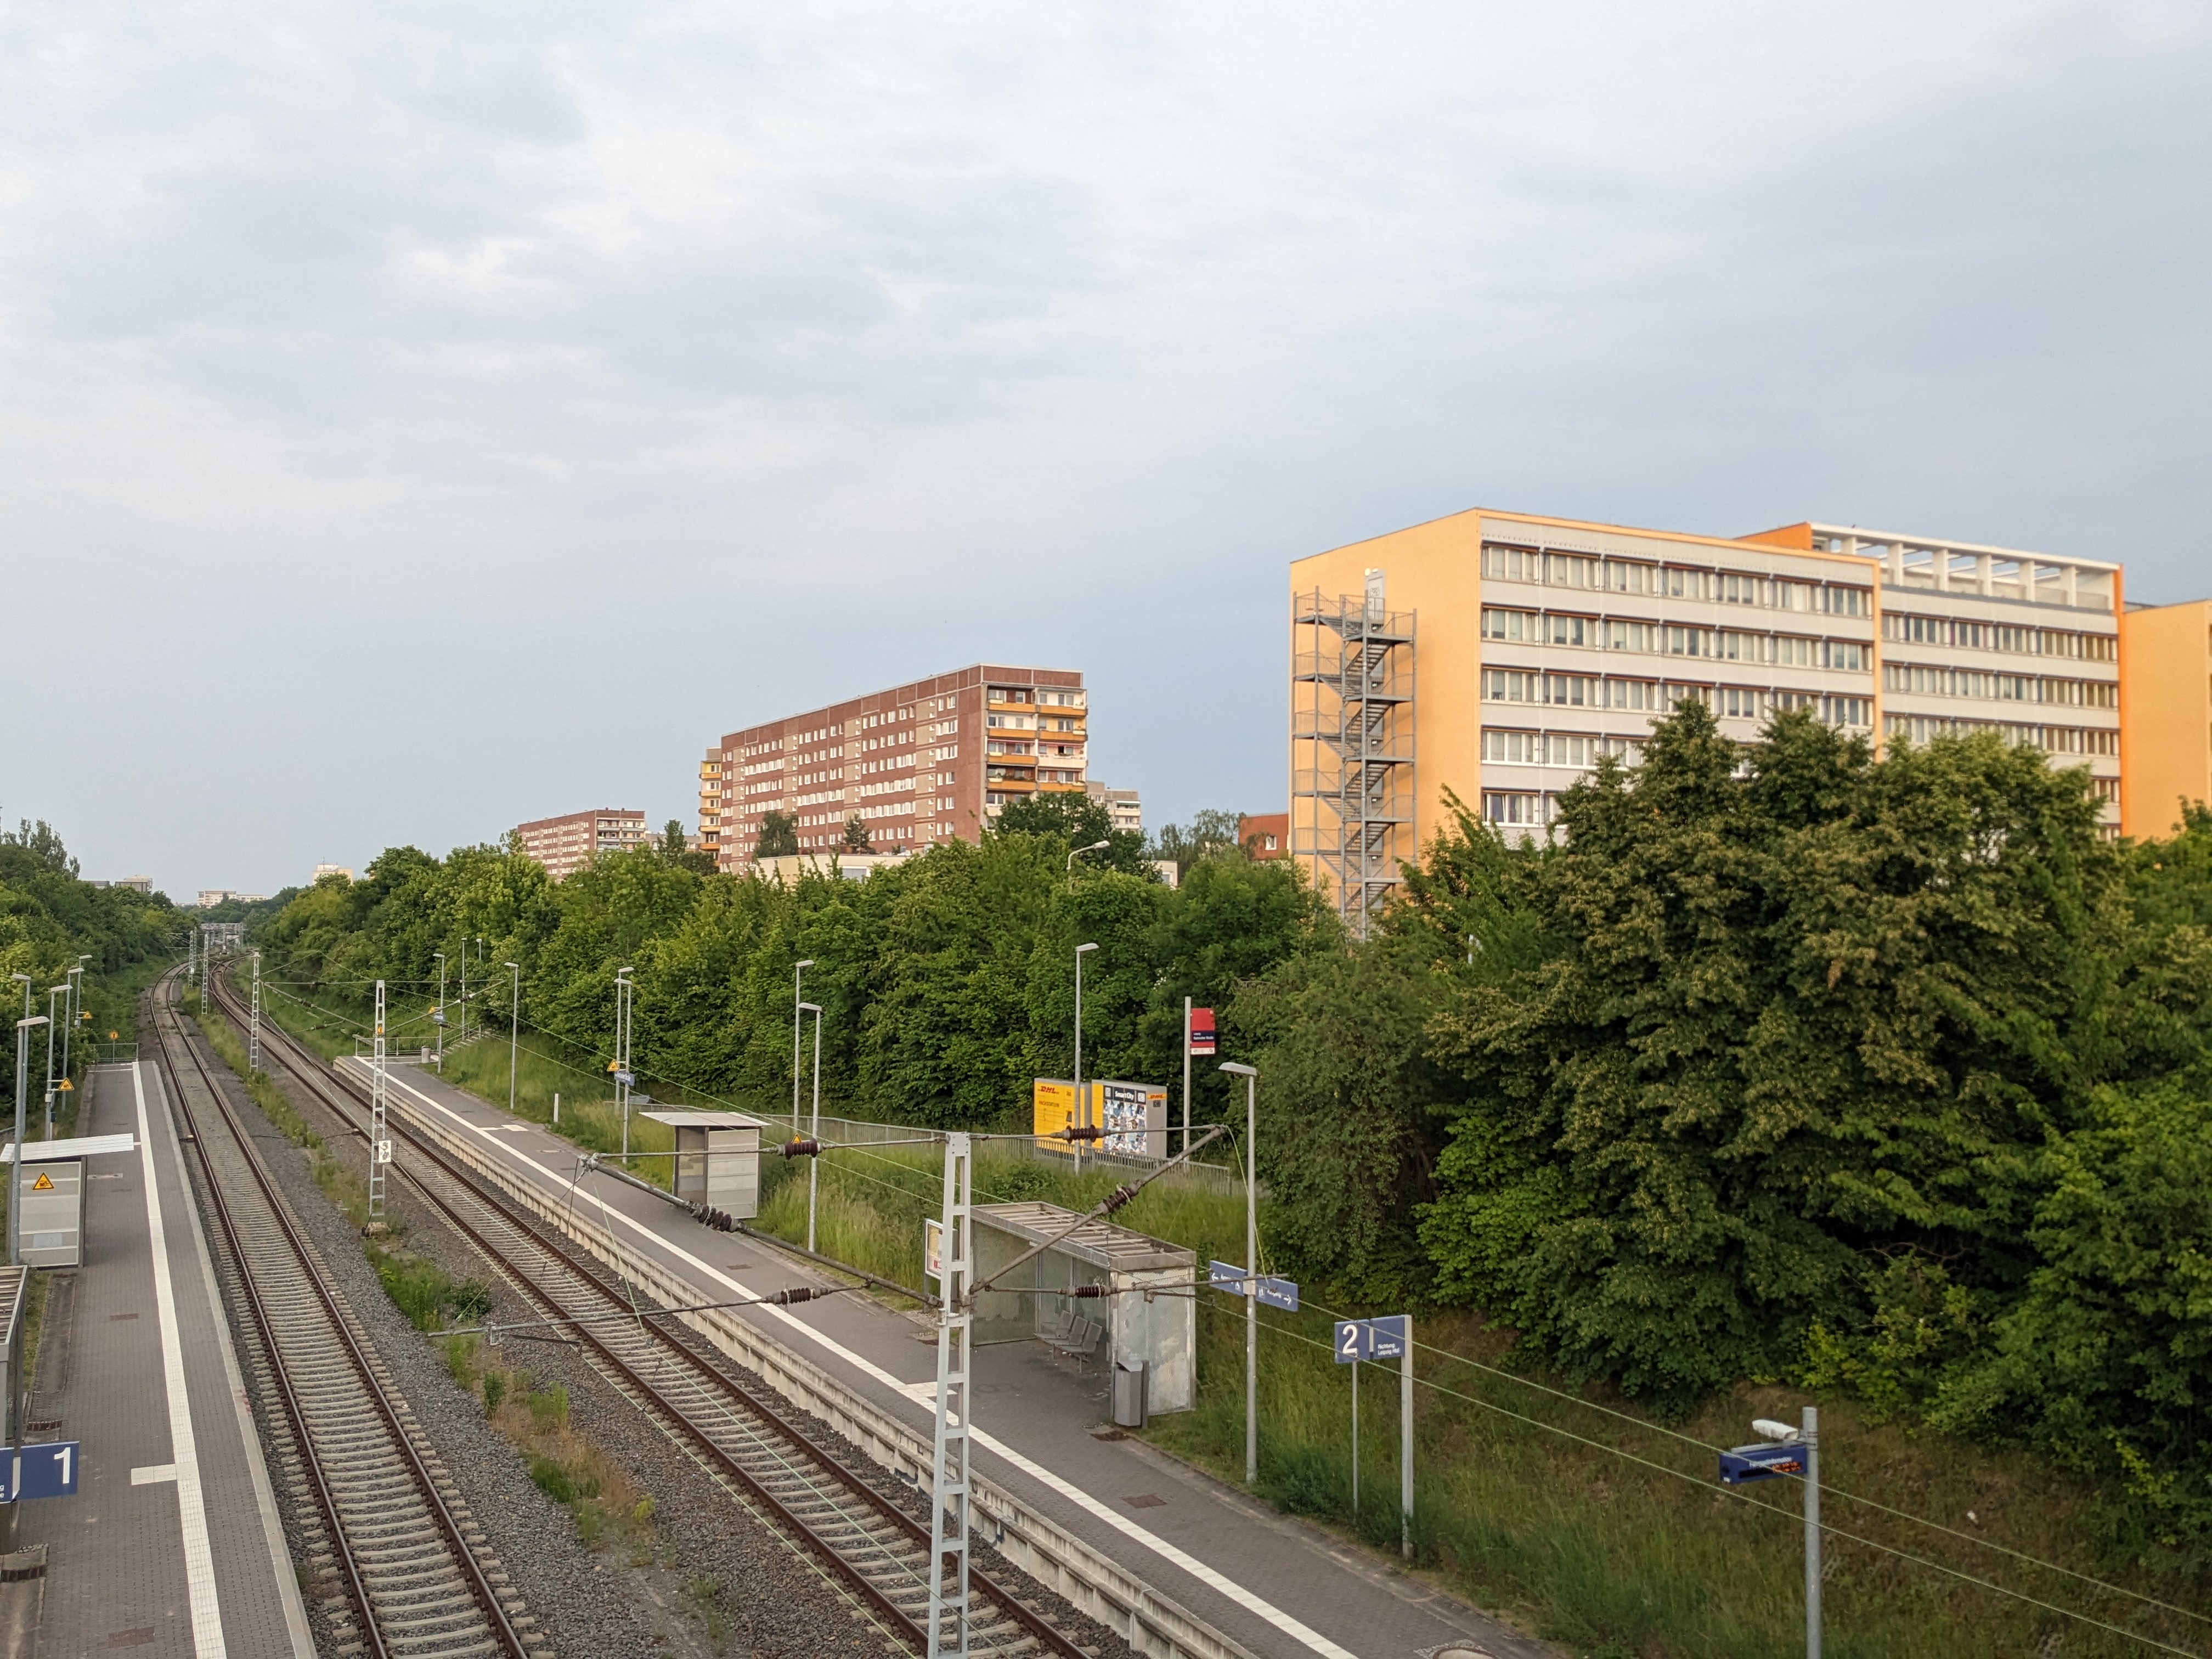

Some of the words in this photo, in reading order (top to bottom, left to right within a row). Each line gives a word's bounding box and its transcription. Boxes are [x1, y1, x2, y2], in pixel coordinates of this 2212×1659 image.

[1041, 1086, 1056, 1094] DHL
[1342, 1324, 1358, 1354] 2
[54, 1447, 71, 1484] 1
